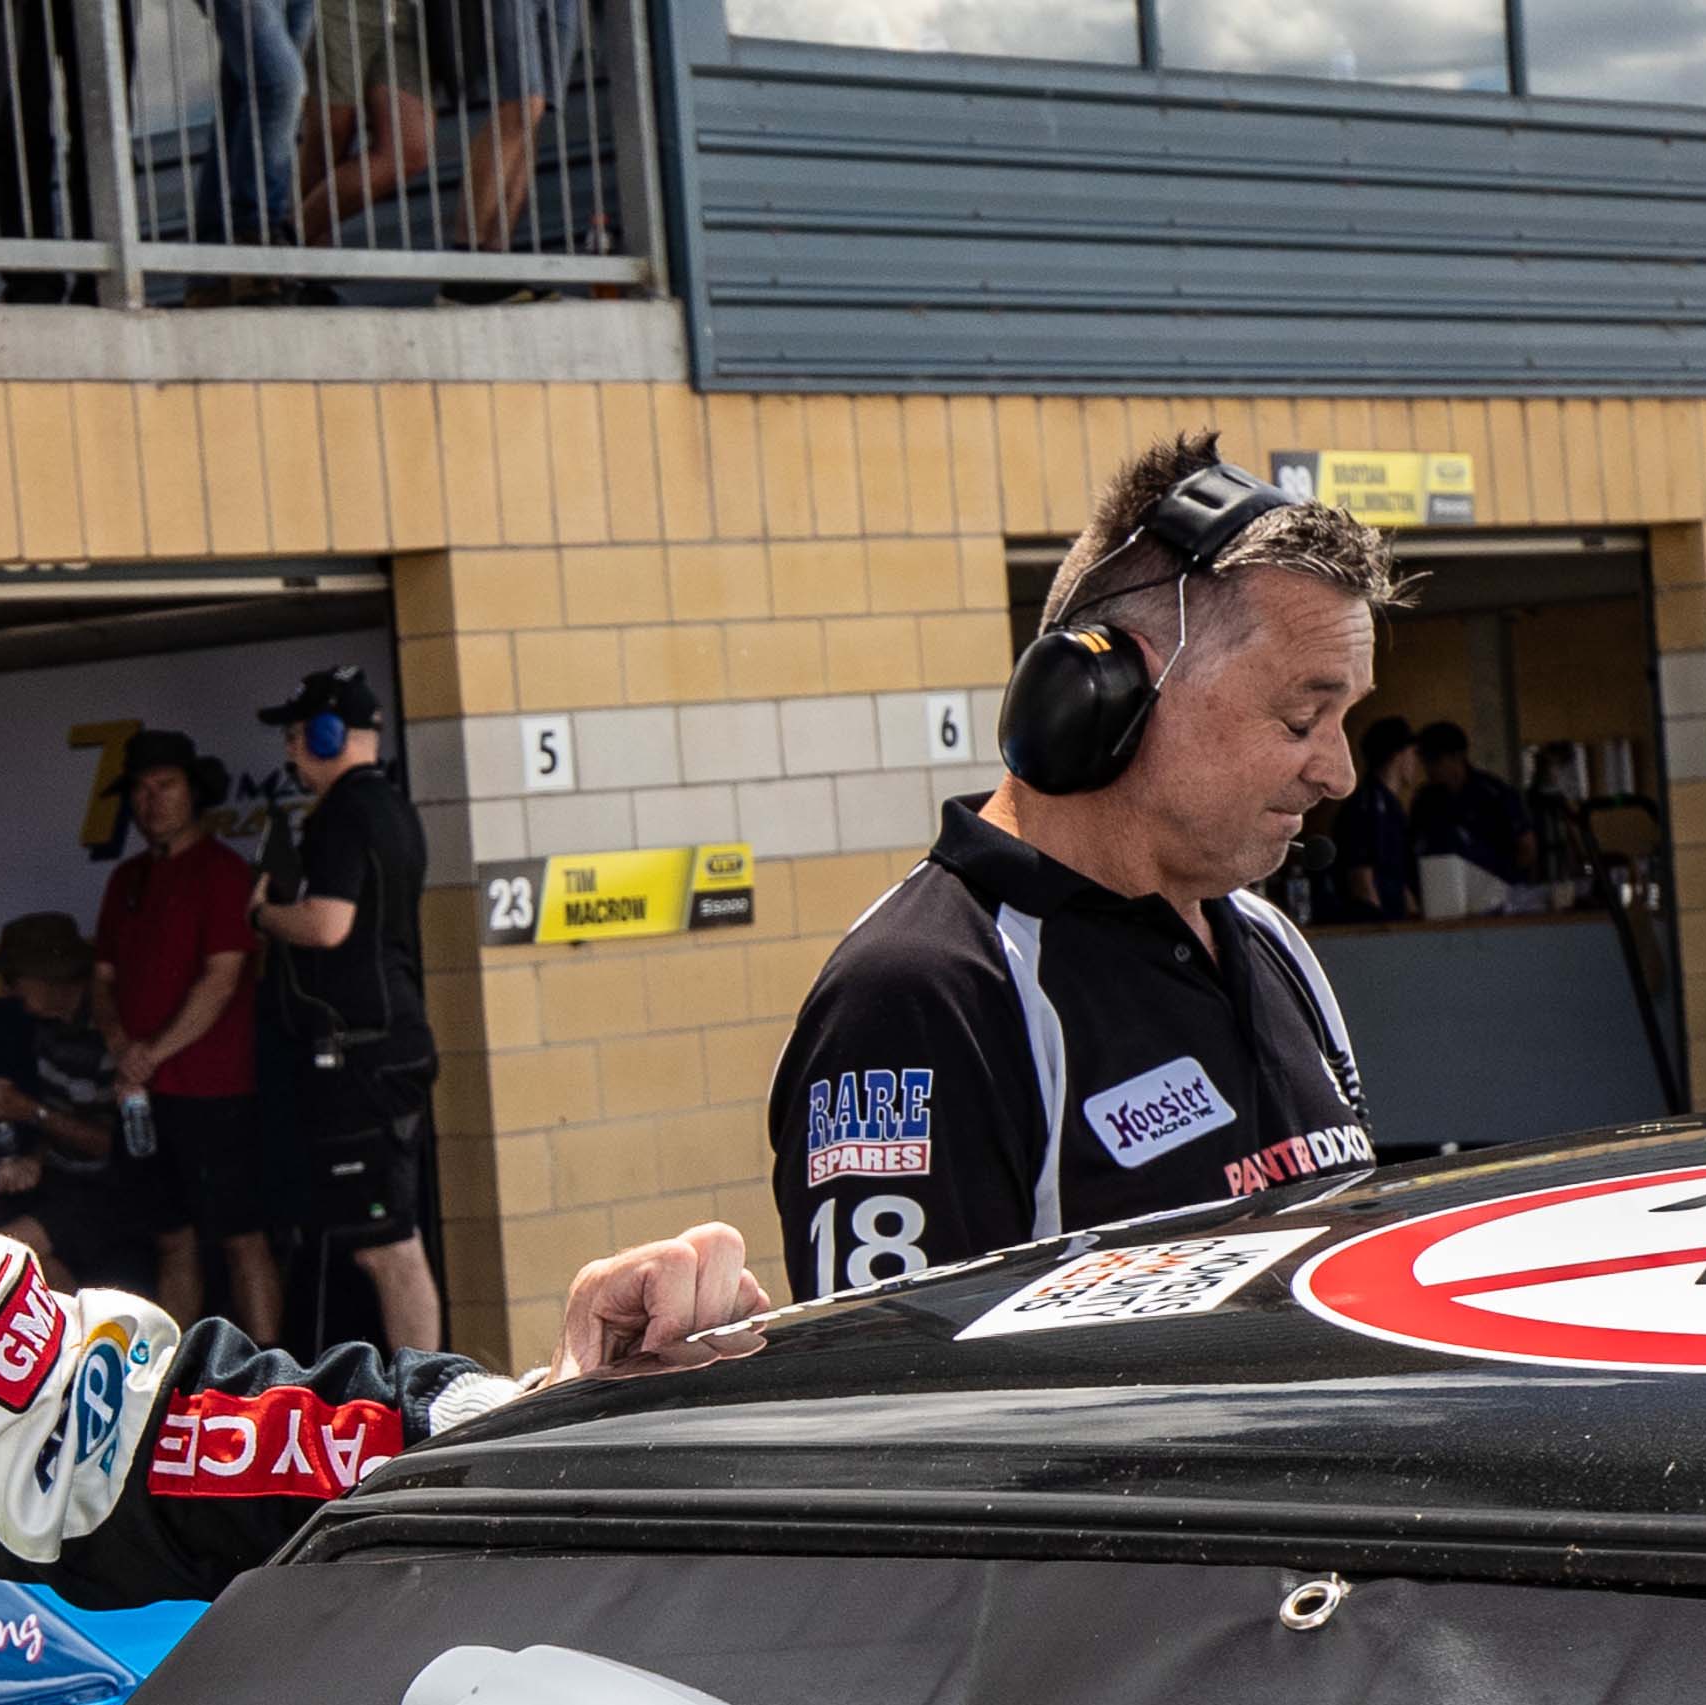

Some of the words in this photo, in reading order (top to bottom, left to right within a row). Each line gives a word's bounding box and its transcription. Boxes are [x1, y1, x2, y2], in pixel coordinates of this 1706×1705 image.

[941, 706, 959, 748] 6
[538, 730, 558, 775] 5
[488, 876, 534, 930] 23
[564, 894, 648, 927] MACROW
[563, 867, 598, 894] TIM
[808, 1068, 934, 1151] RARE
[1105, 1075, 1211, 1151] Hoosier
[811, 1145, 923, 1182] SPARES
[809, 1194, 928, 1299] 18
